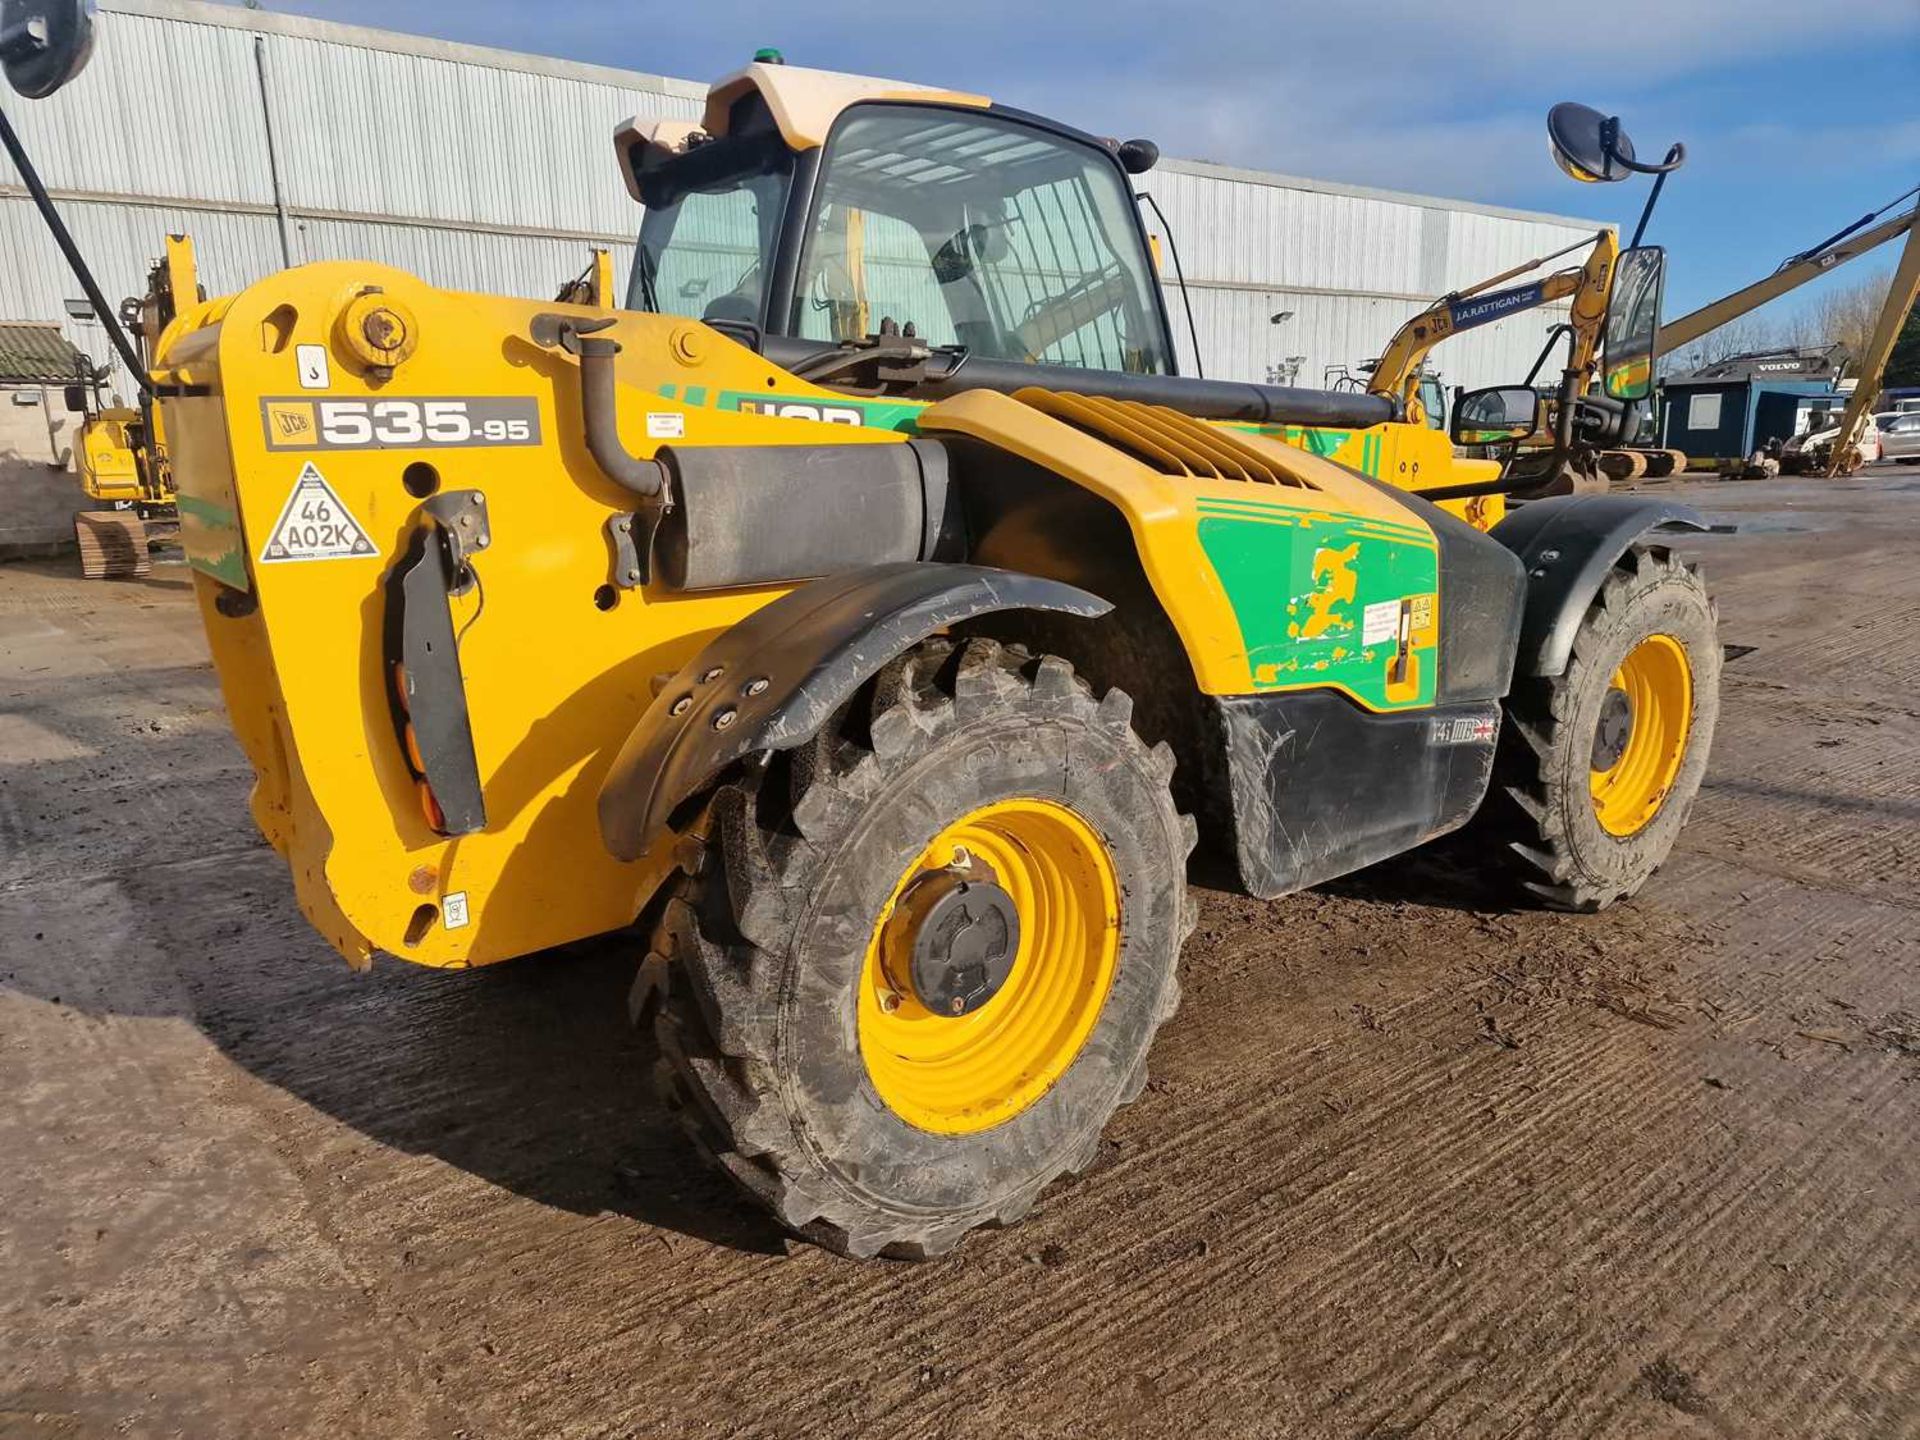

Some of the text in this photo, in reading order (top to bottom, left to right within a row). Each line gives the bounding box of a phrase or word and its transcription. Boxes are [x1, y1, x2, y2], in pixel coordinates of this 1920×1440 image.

[1758, 362, 1800, 371] VOLVO
[281, 401, 530, 444] JCB 535-95
[301, 500, 331, 523] 46
